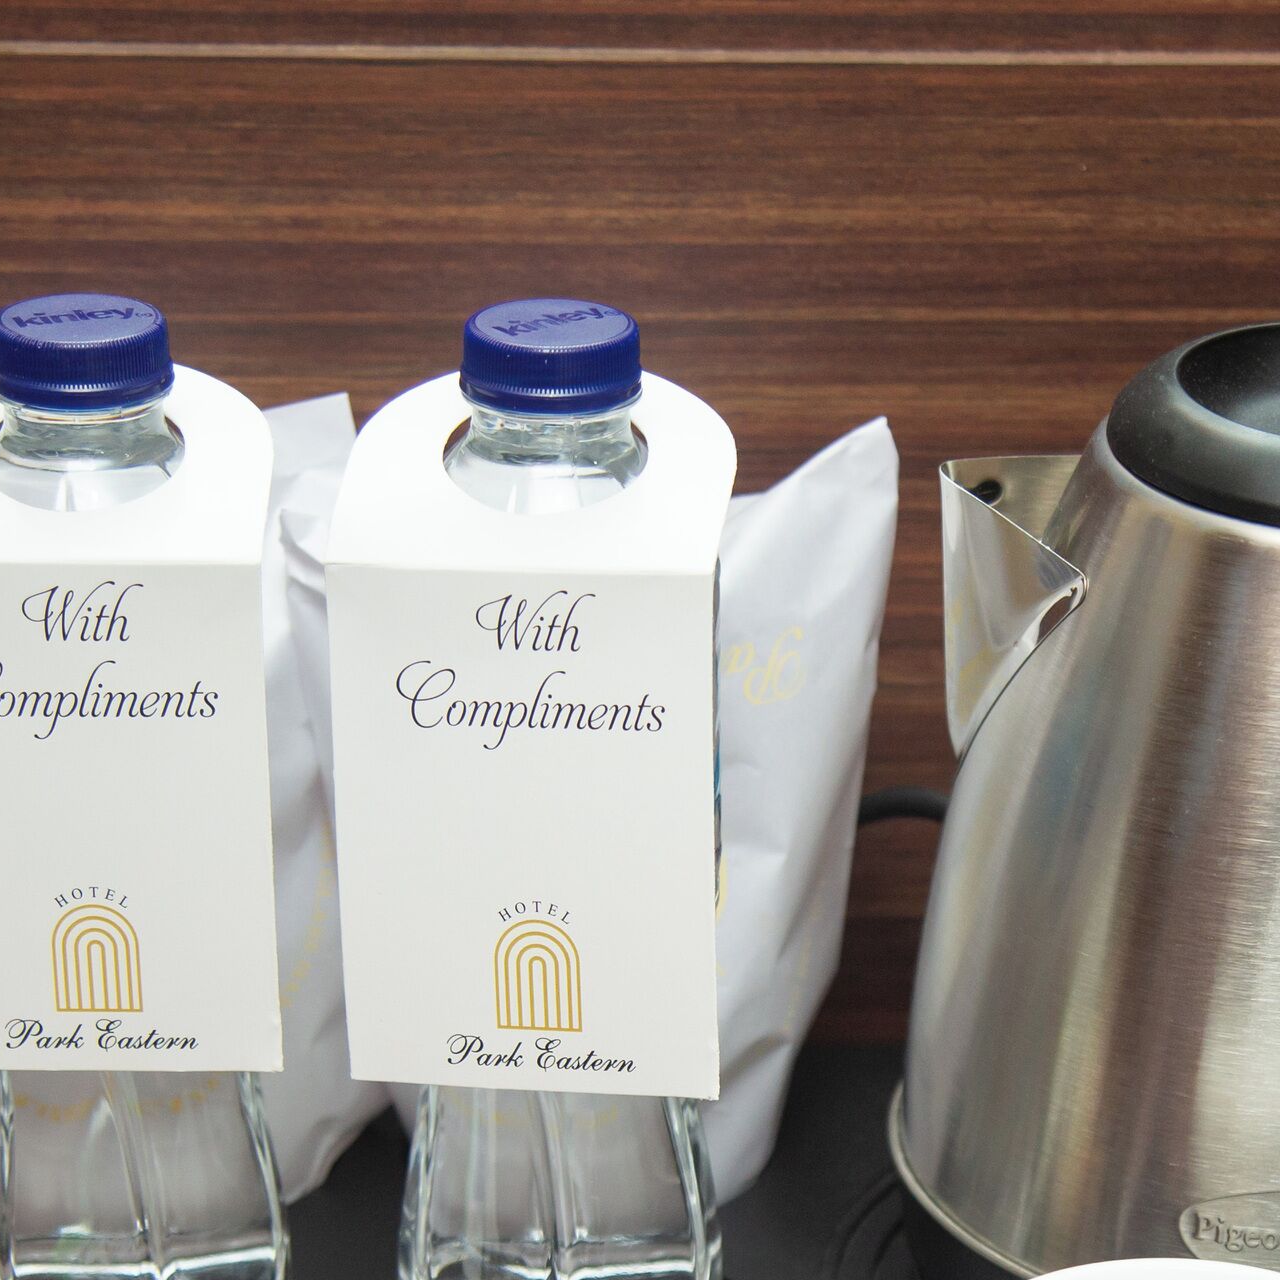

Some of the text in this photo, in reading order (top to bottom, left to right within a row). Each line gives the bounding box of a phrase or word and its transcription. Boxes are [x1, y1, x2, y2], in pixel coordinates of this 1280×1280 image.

[21, 580, 144, 643] With
[475, 589, 596, 653] With
[395, 660, 666, 750] Compliments
[54, 886, 129, 910] HOTEL
[498, 899, 572, 924] HOTEL
[4, 1018, 199, 1053] Park Eastern
[446, 1033, 636, 1073] Park Eastern
